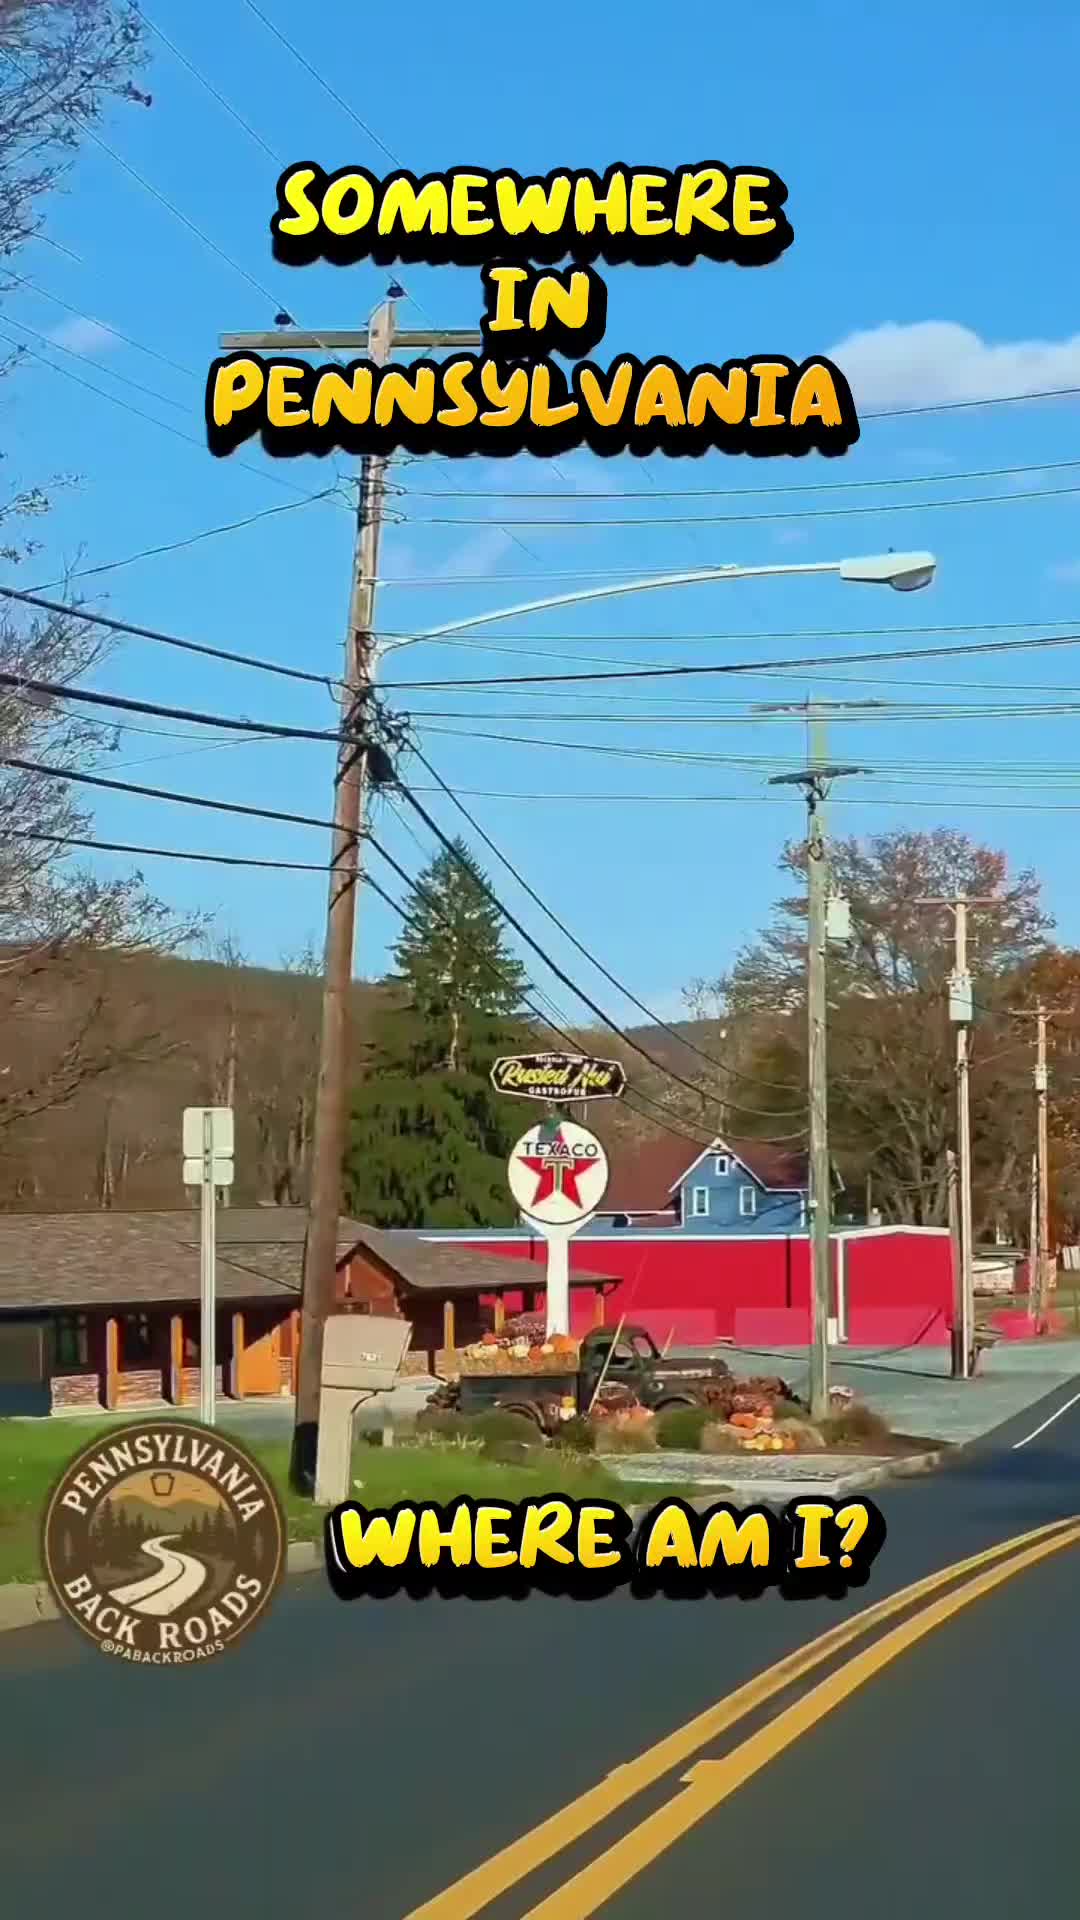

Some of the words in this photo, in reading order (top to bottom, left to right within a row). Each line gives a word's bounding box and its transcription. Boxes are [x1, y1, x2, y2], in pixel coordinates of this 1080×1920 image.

[498, 1059, 572, 1087] Rusted
[528, 1087, 586, 1096] GASTROPUB
[523, 1141, 598, 1157] TEXACO
[542, 1158, 575, 1192] T
